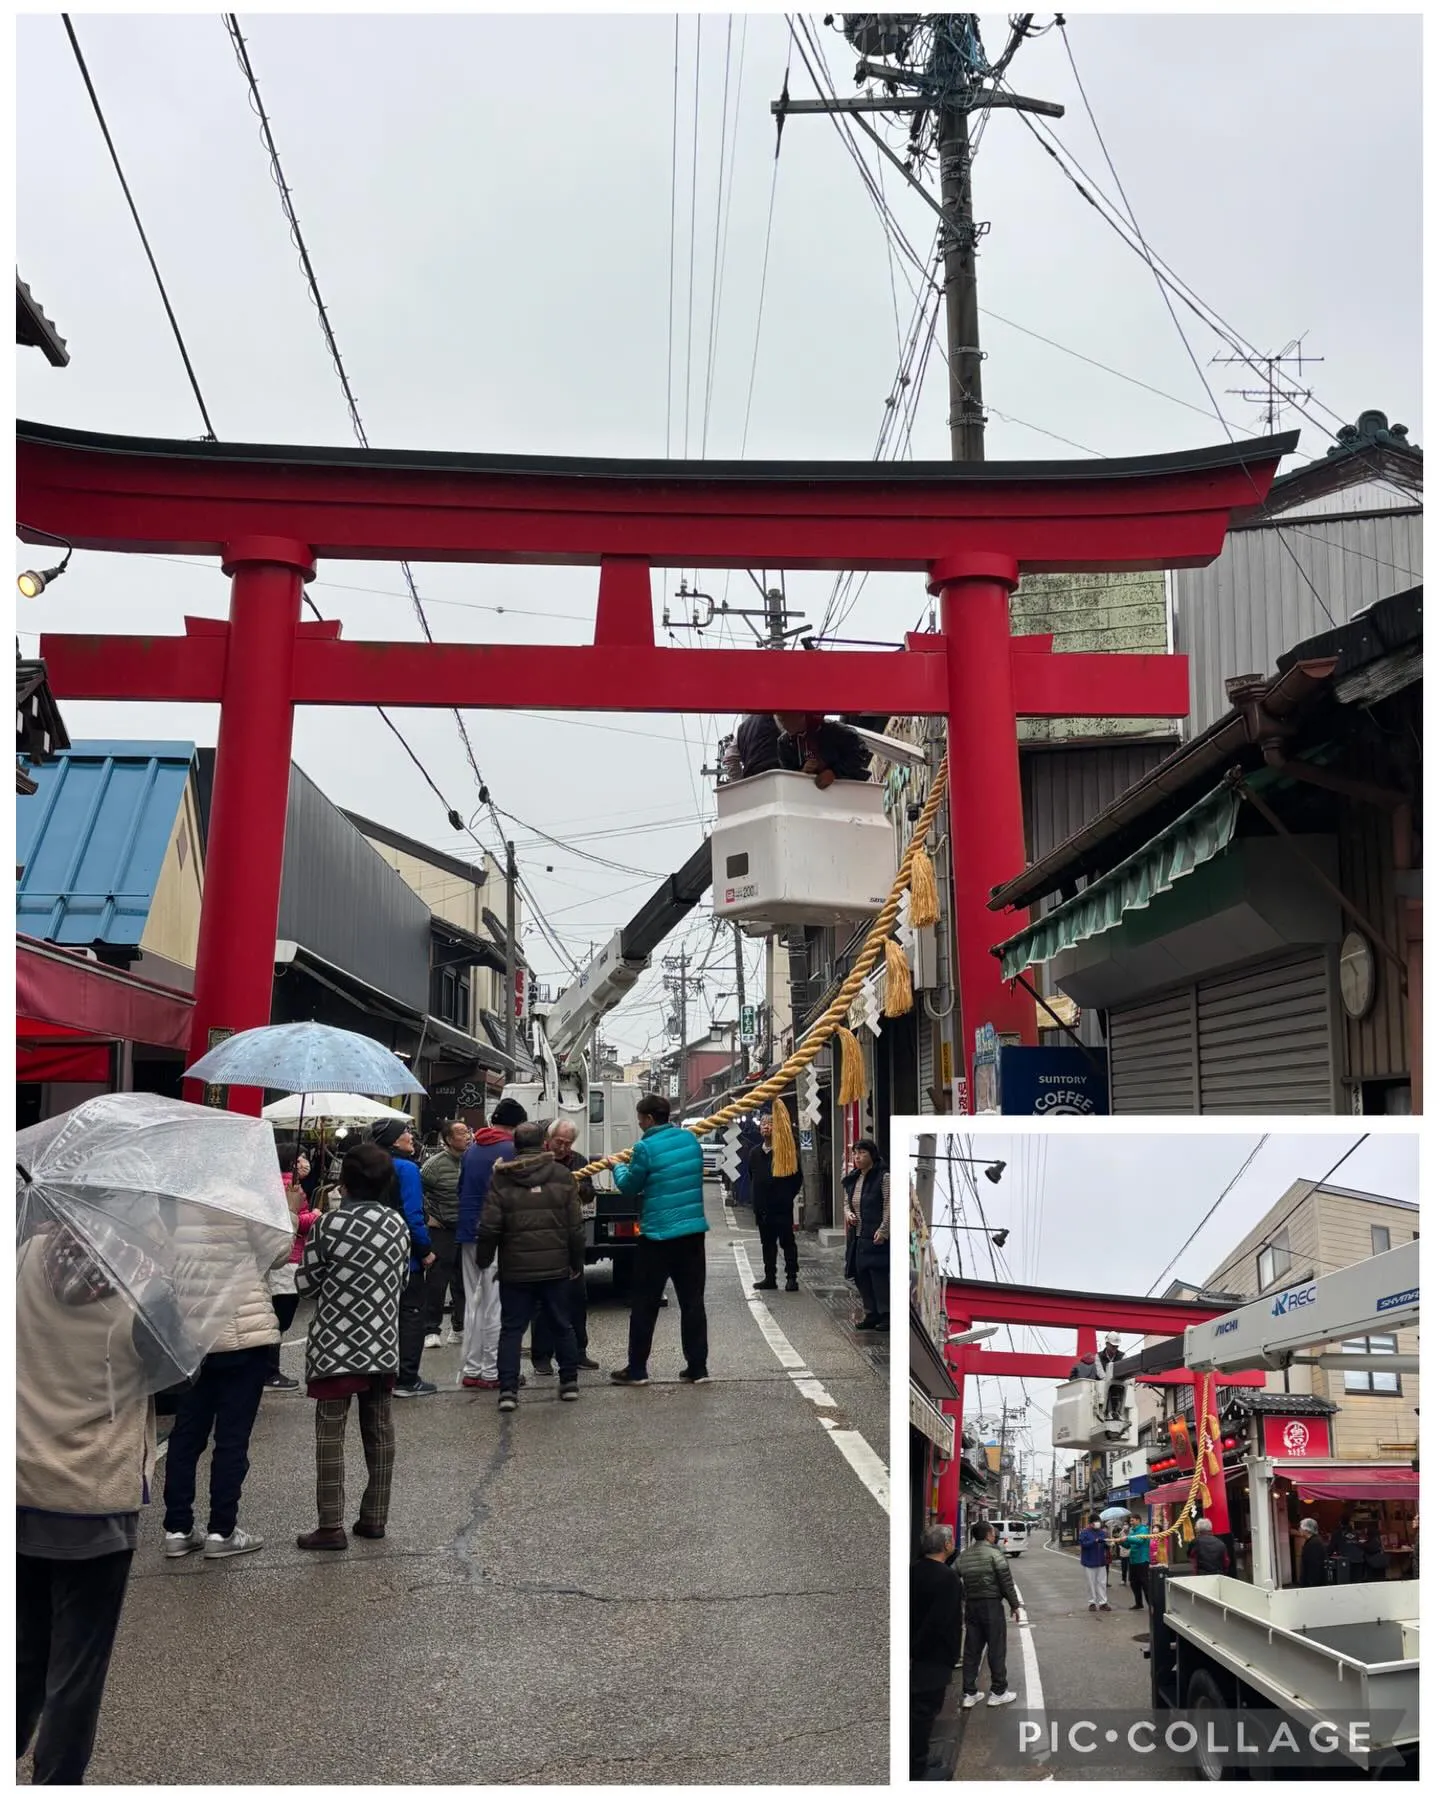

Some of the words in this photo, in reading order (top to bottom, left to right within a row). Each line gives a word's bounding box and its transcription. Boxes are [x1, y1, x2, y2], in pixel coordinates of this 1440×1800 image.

[1035, 1090, 1094, 1112] COFFEE
[1288, 1286, 1316, 1308] REC
[1215, 1319, 1238, 1336] AICHI
